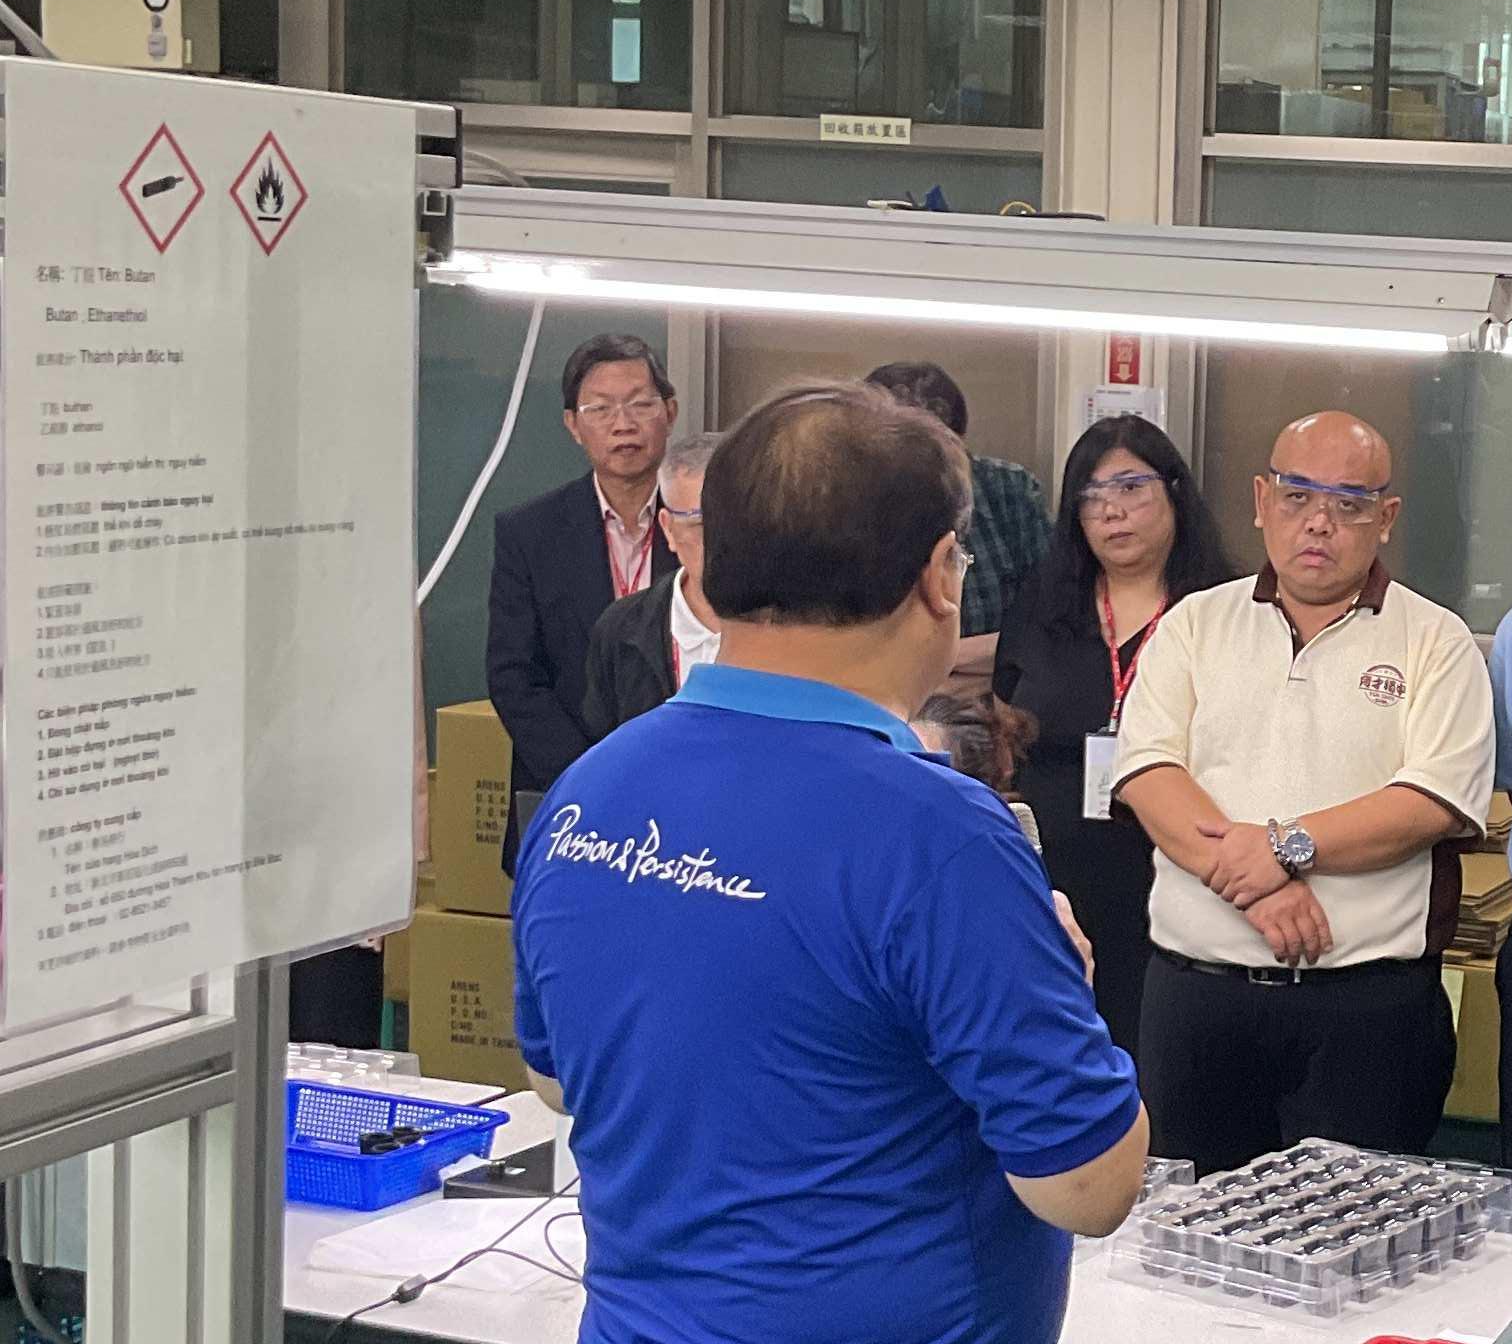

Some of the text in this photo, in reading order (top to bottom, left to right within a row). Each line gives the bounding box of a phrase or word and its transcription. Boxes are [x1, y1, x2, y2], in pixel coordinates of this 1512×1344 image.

[125, 267, 156, 283] Butan
[46, 307, 79, 323] Butan
[546, 804, 618, 862] Passion
[627, 819, 767, 899] Persistence
